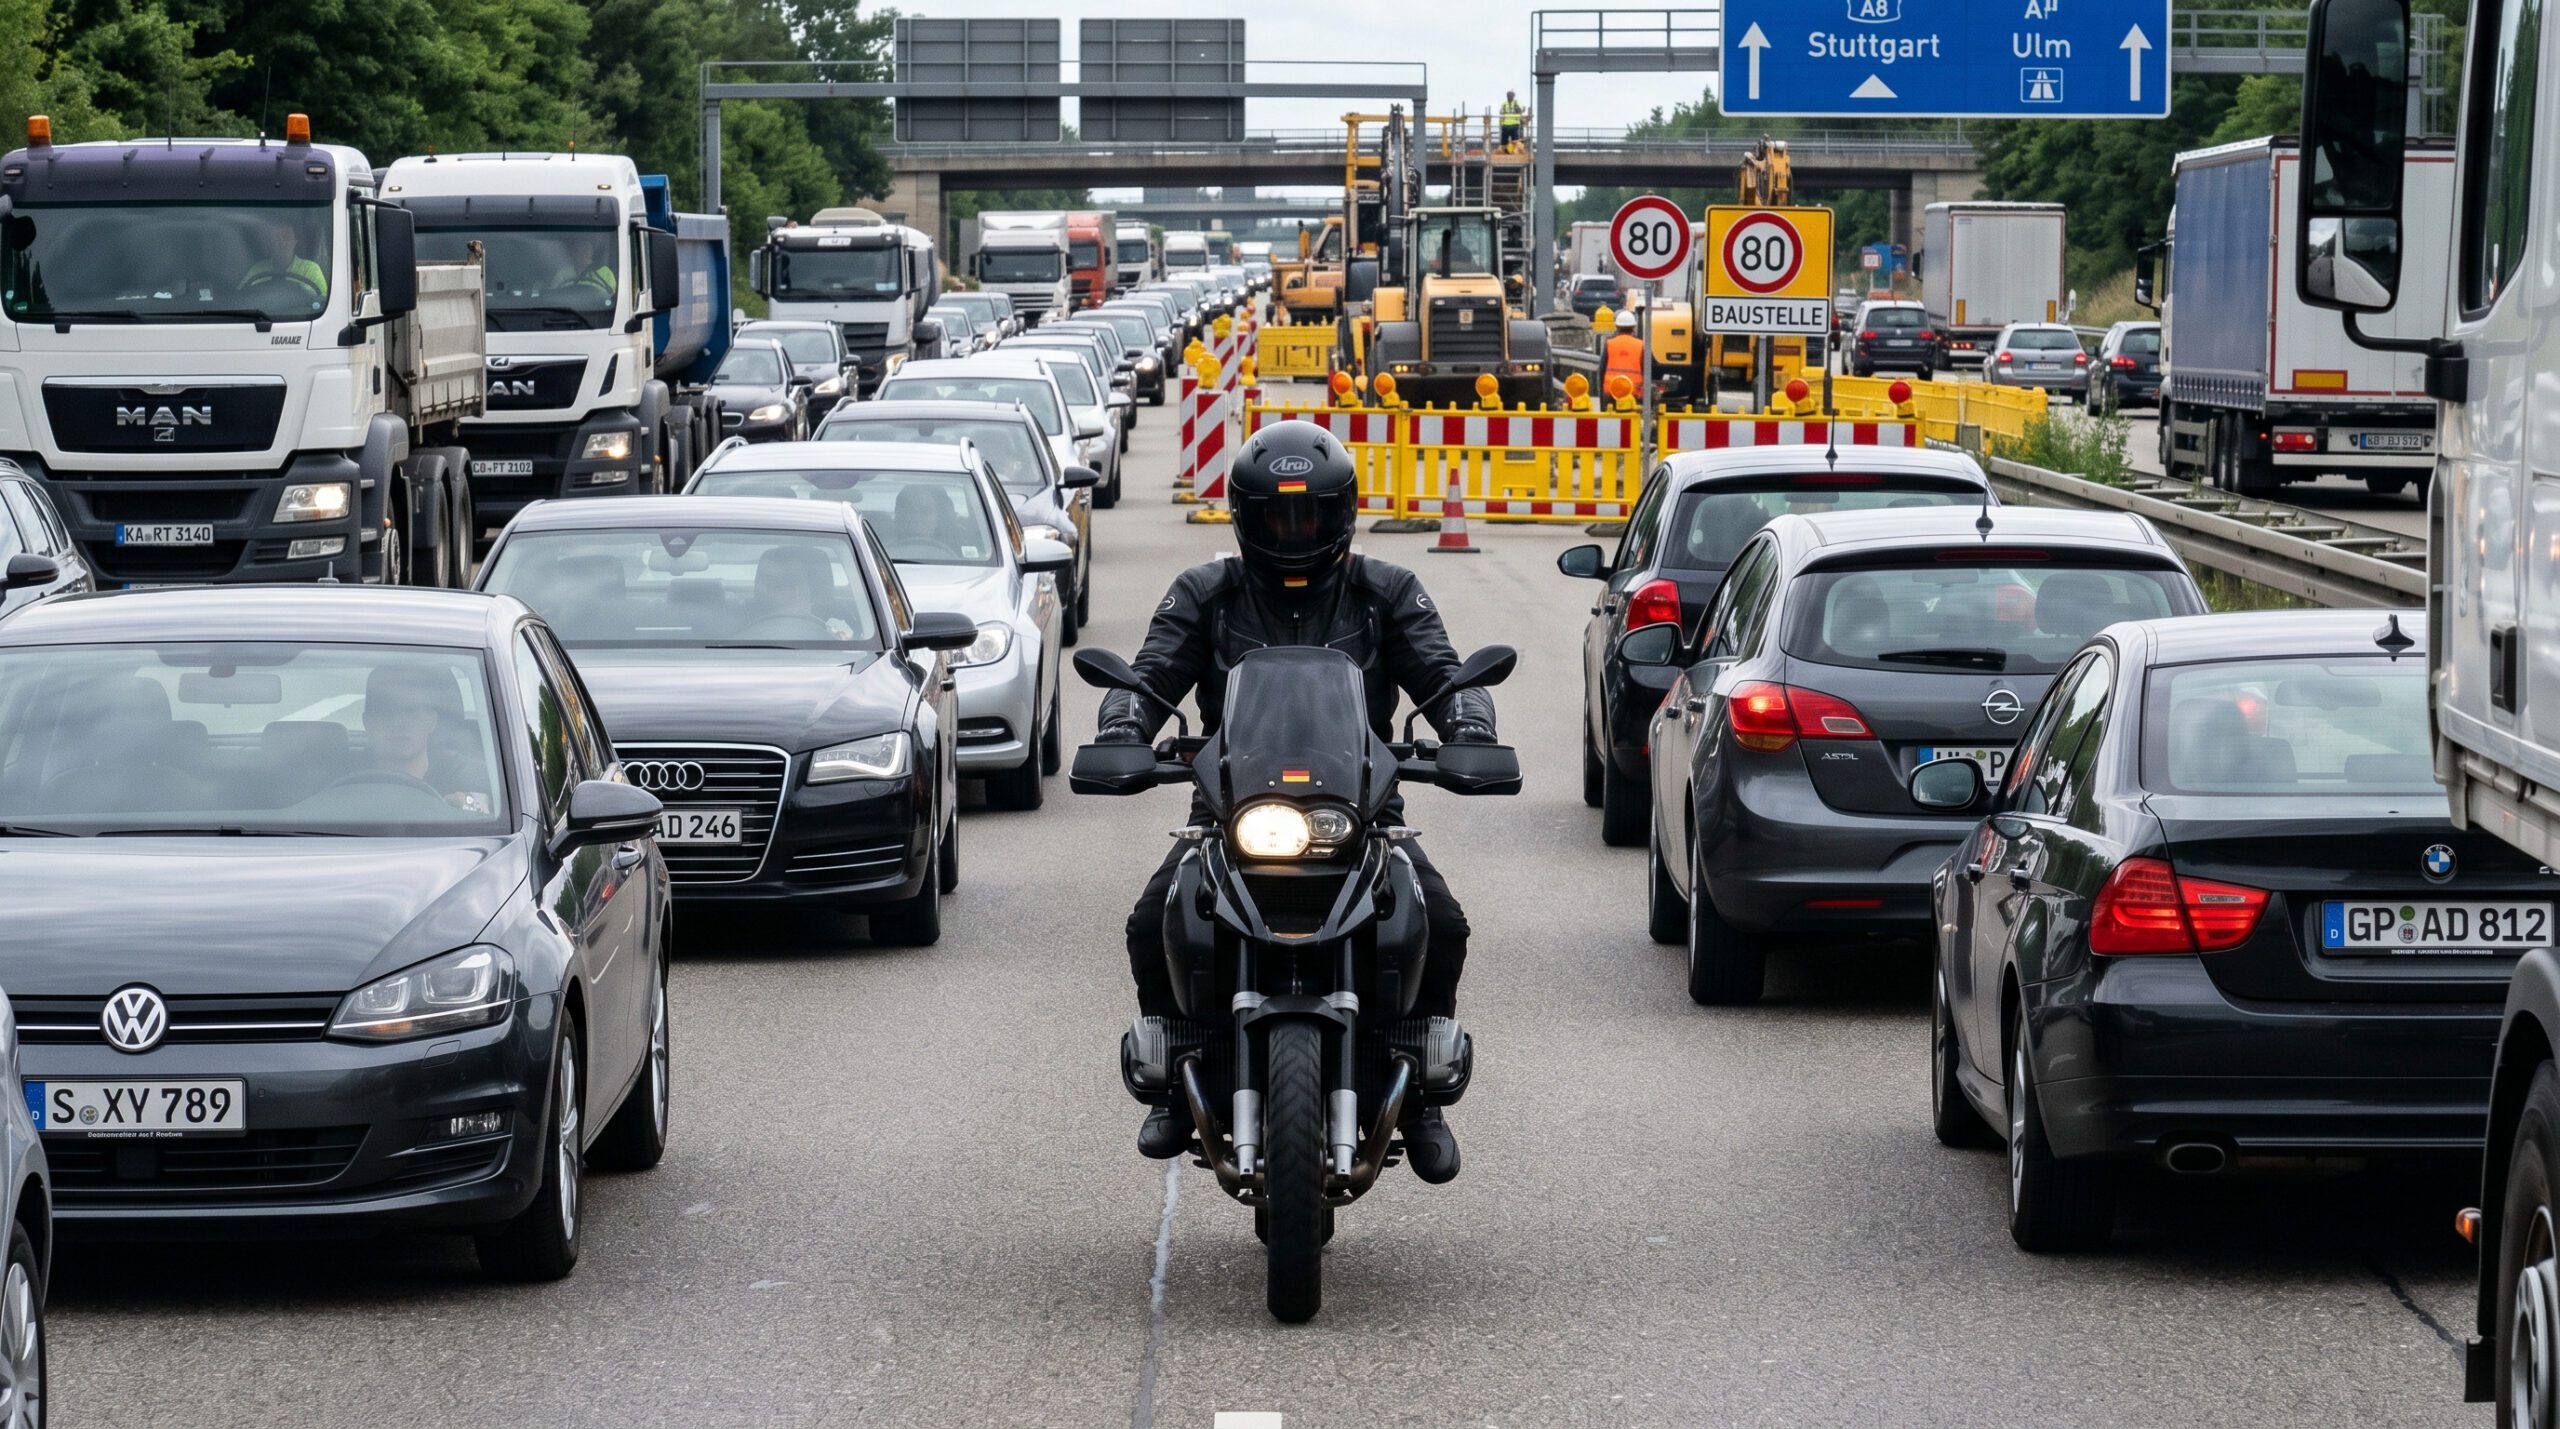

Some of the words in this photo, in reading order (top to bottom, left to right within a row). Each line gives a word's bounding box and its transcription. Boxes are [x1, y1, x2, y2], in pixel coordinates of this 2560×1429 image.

[1859, 0, 1889, 18] A8
[1807, 31, 1941, 65] Stuttgart
[2012, 32, 2071, 58] Ulm
[1628, 221, 1672, 256] 80
[1740, 235, 1785, 271] 80
[1711, 305, 1823, 326] BAUSTELLE
[486, 380, 535, 396] AN
[116, 406, 212, 426] MAN
[125, 527, 144, 542] KA
[153, 527, 172, 542] RT
[175, 527, 211, 542] 3140
[689, 815, 736, 839] 246
[2348, 907, 2396, 942] GP
[2421, 907, 2469, 942] AD
[2478, 907, 2547, 942] 812
[52, 1088, 75, 1124] S
[102, 1088, 150, 1124] XY
[161, 1087, 232, 1124] 789
